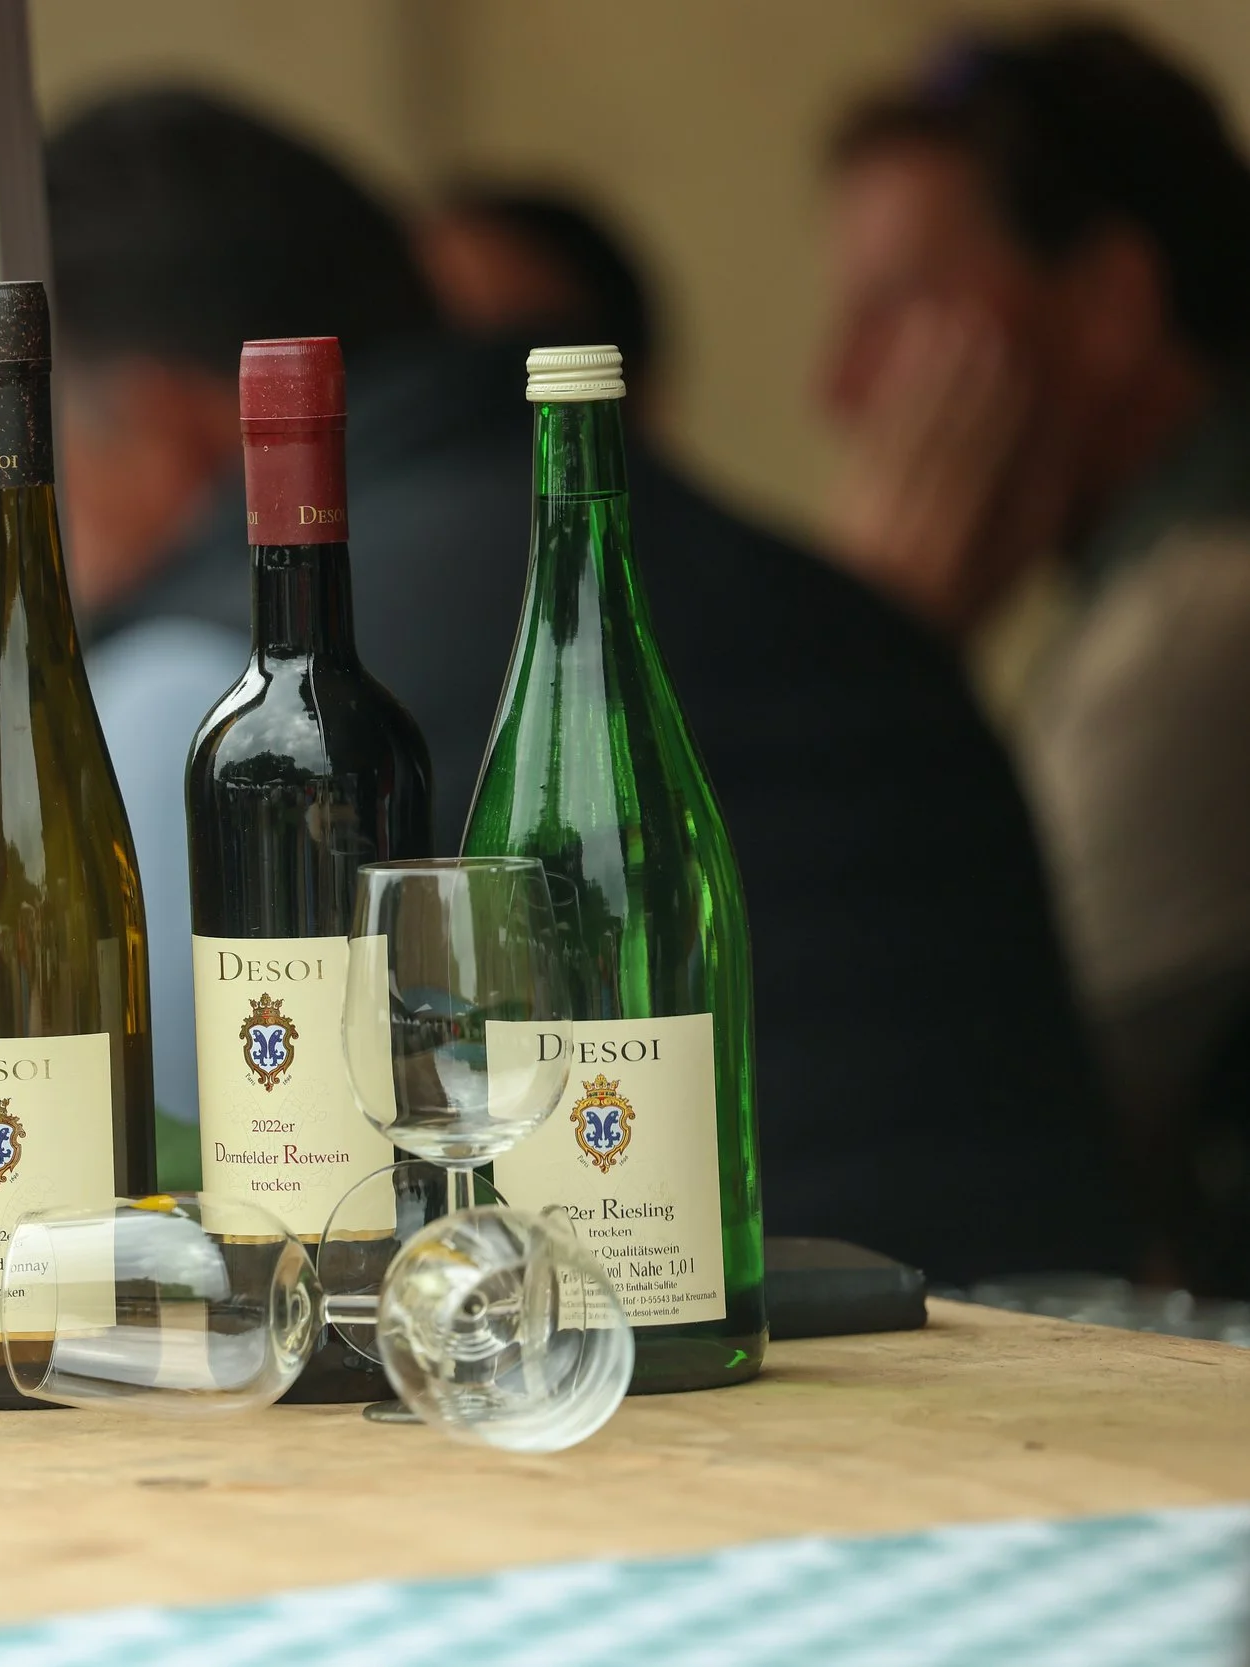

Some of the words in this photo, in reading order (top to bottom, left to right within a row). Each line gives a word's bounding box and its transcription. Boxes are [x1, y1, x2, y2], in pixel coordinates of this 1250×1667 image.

[217, 951, 324, 982] DESOI
[251, 1119, 295, 1133] 2022er
[215, 1142, 279, 1164] Dornfelder
[283, 1144, 349, 1165] Rotwein
[251, 1178, 301, 1191] trocken
[602, 1198, 674, 1221] Riesling
[589, 1227, 632, 1238] trocken
[602, 1243, 680, 1259] Qualitätswein
[607, 1262, 621, 1278] vol
[630, 1261, 663, 1277] Nahe
[626, 1281, 654, 1292] Enthält
[654, 1280, 678, 1291] Sulfite
[622, 1296, 636, 1306] Hof
[671, 1292, 684, 1303] Bad
[685, 1289, 717, 1301] Kreuznach
